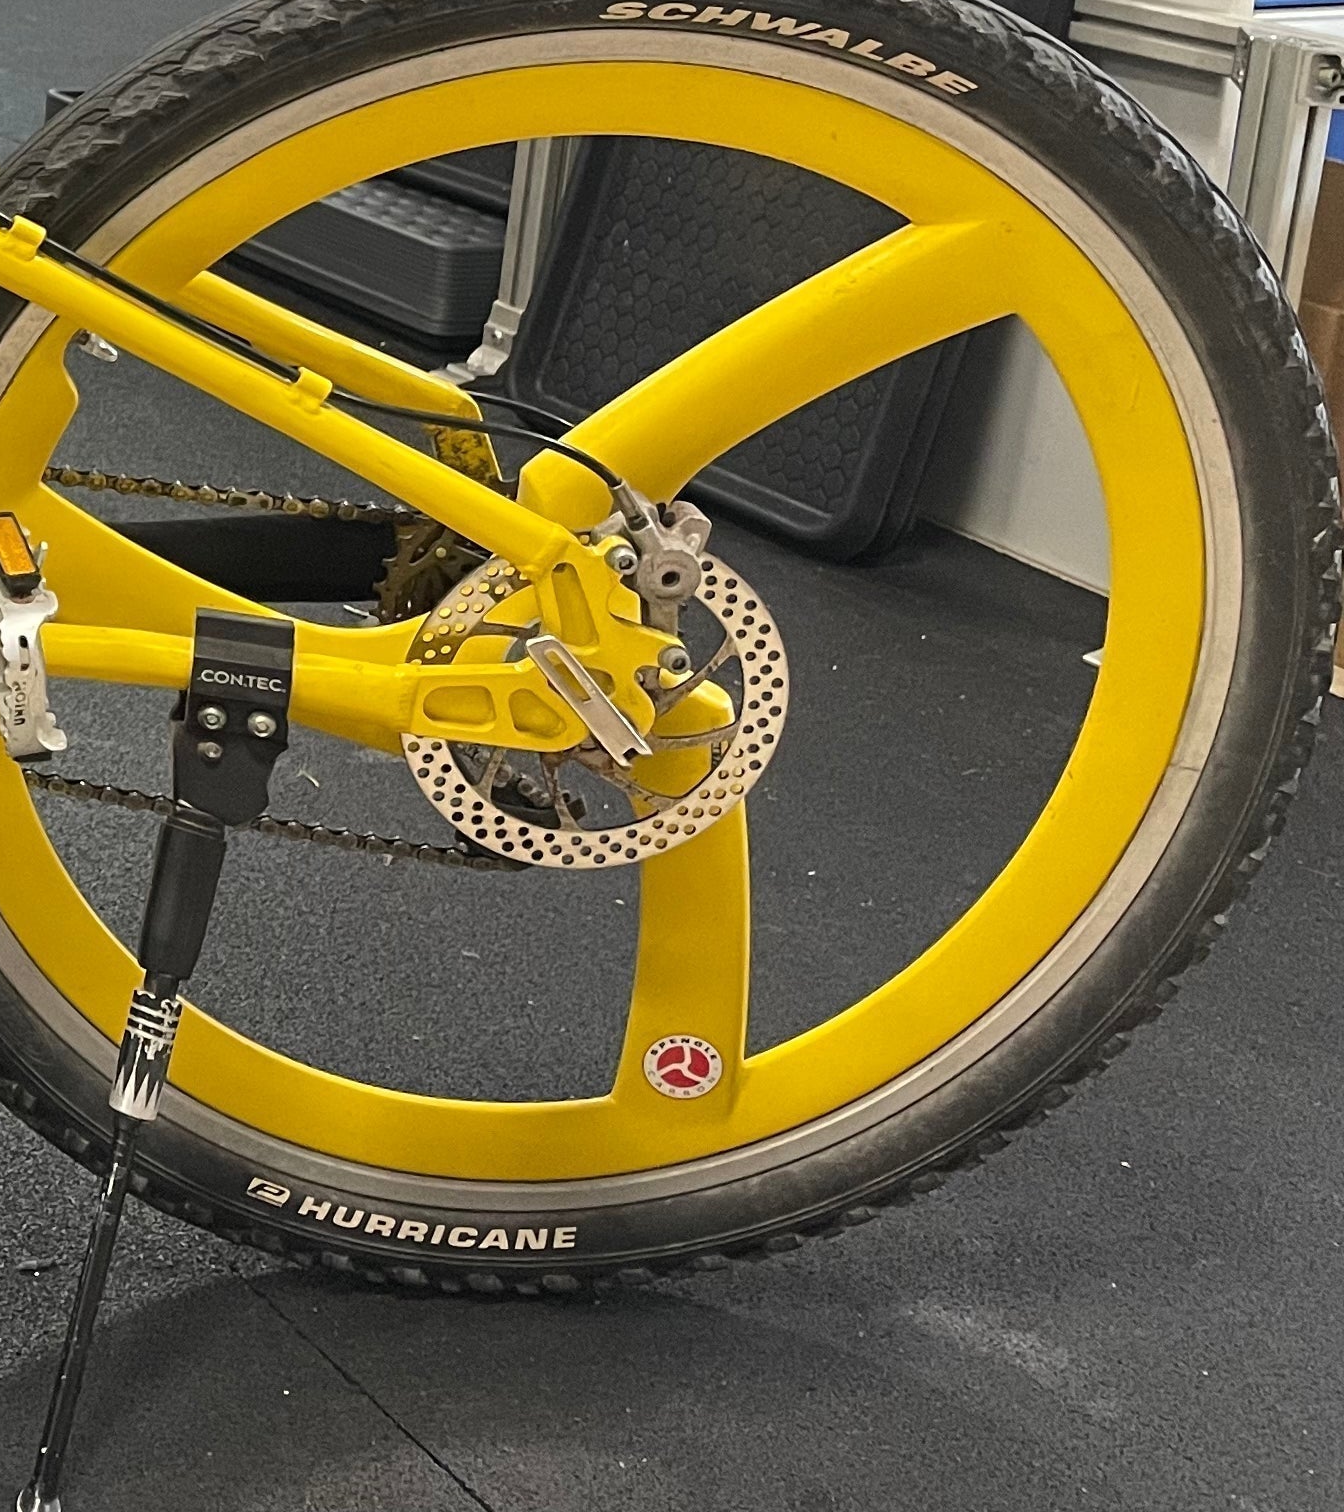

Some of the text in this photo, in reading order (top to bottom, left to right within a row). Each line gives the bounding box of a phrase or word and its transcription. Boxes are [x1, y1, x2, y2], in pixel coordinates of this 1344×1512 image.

[598, 1, 979, 95] SCHWALBE
[650, 1037, 718, 1061] SPENGLE
[647, 1070, 717, 1096] CARBON
[297, 1195, 578, 1251] HURRICANE
